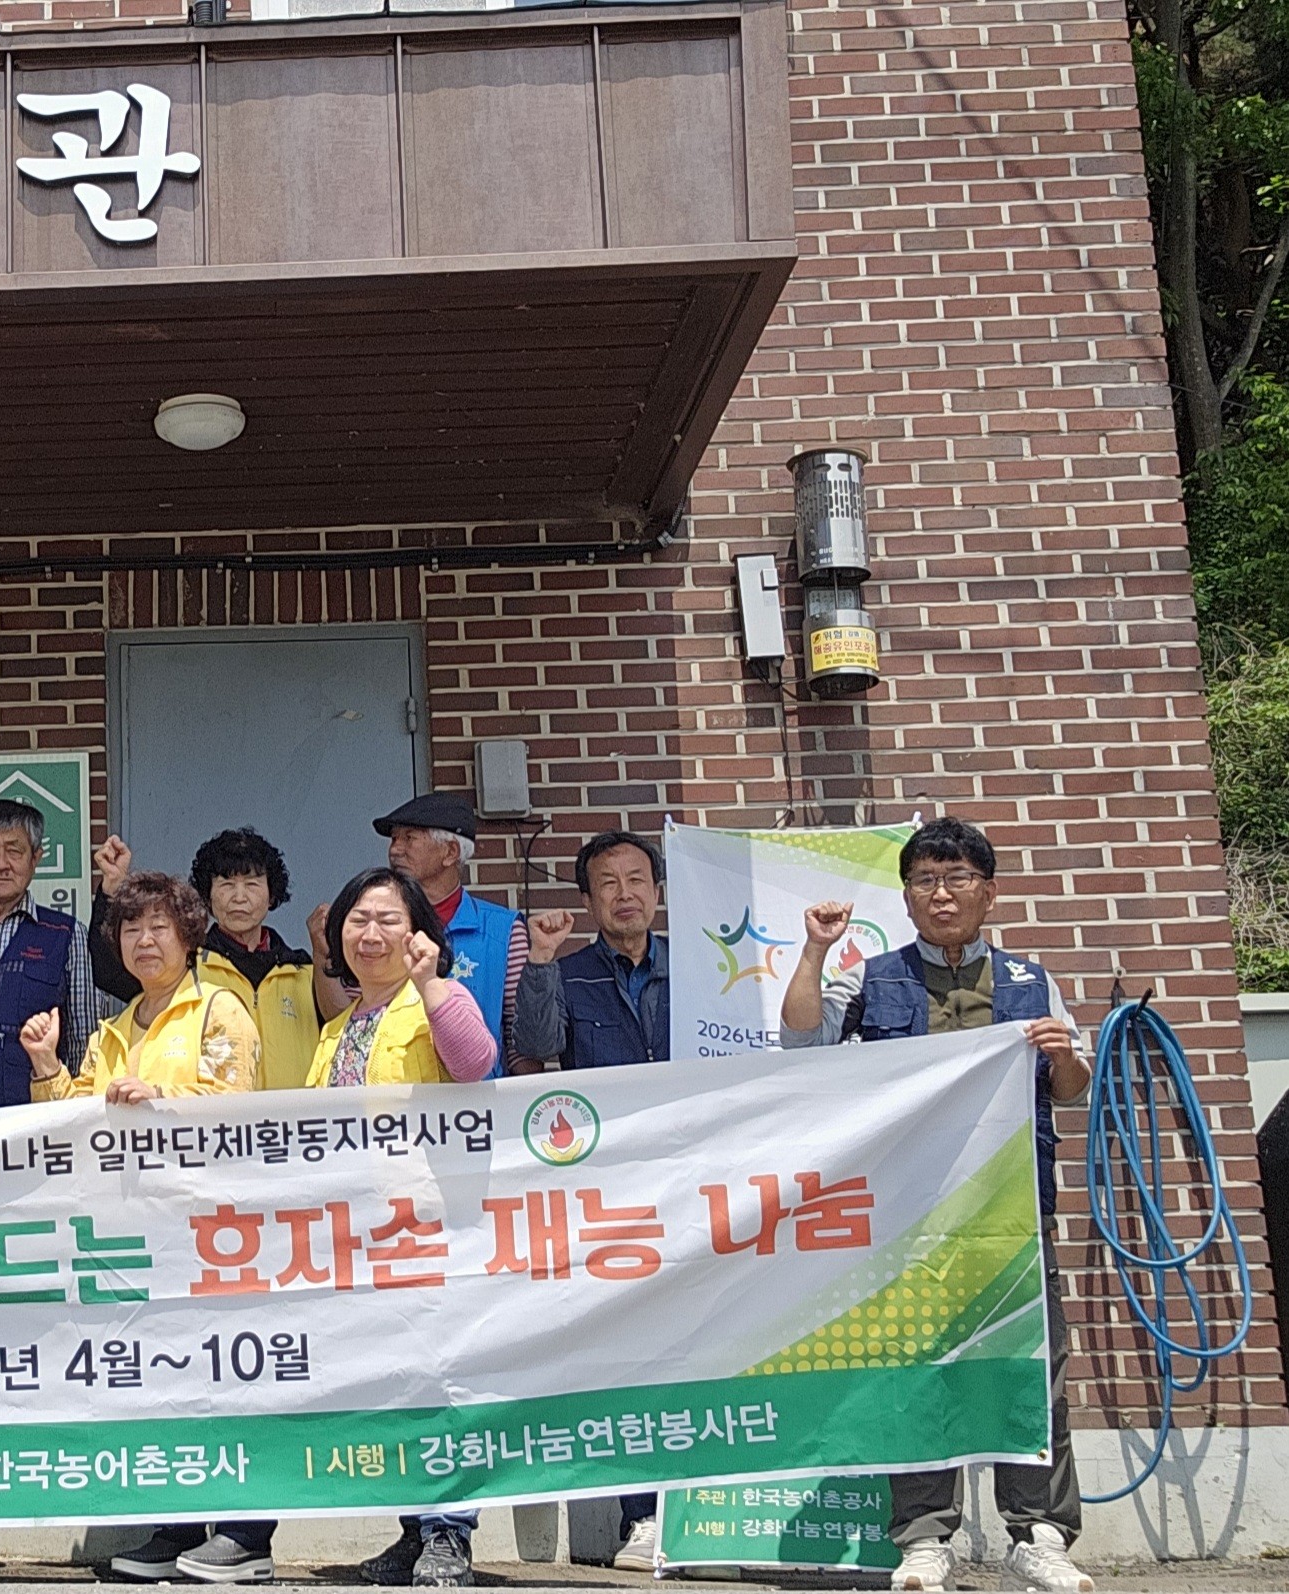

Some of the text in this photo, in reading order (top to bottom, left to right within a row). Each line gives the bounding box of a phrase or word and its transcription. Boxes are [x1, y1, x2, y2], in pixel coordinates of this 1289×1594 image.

[696, 1019, 781, 1049] 2026년도
[89, 1109, 494, 1172] 일반단체활동지원사업
[189, 1197, 450, 1296] 효자손
[482, 1187, 666, 1281] 재능
[699, 1171, 875, 1255] 나눔
[64, 1330, 311, 1389] 4월~10월
[326, 1443, 385, 1478] 시행
[419, 1401, 779, 1476] 강화나눔연합봉사단
[695, 1488, 882, 1510] 주관 한국농어촌공사
[694, 1518, 889, 1542] 시행 강화나눔연합봉
